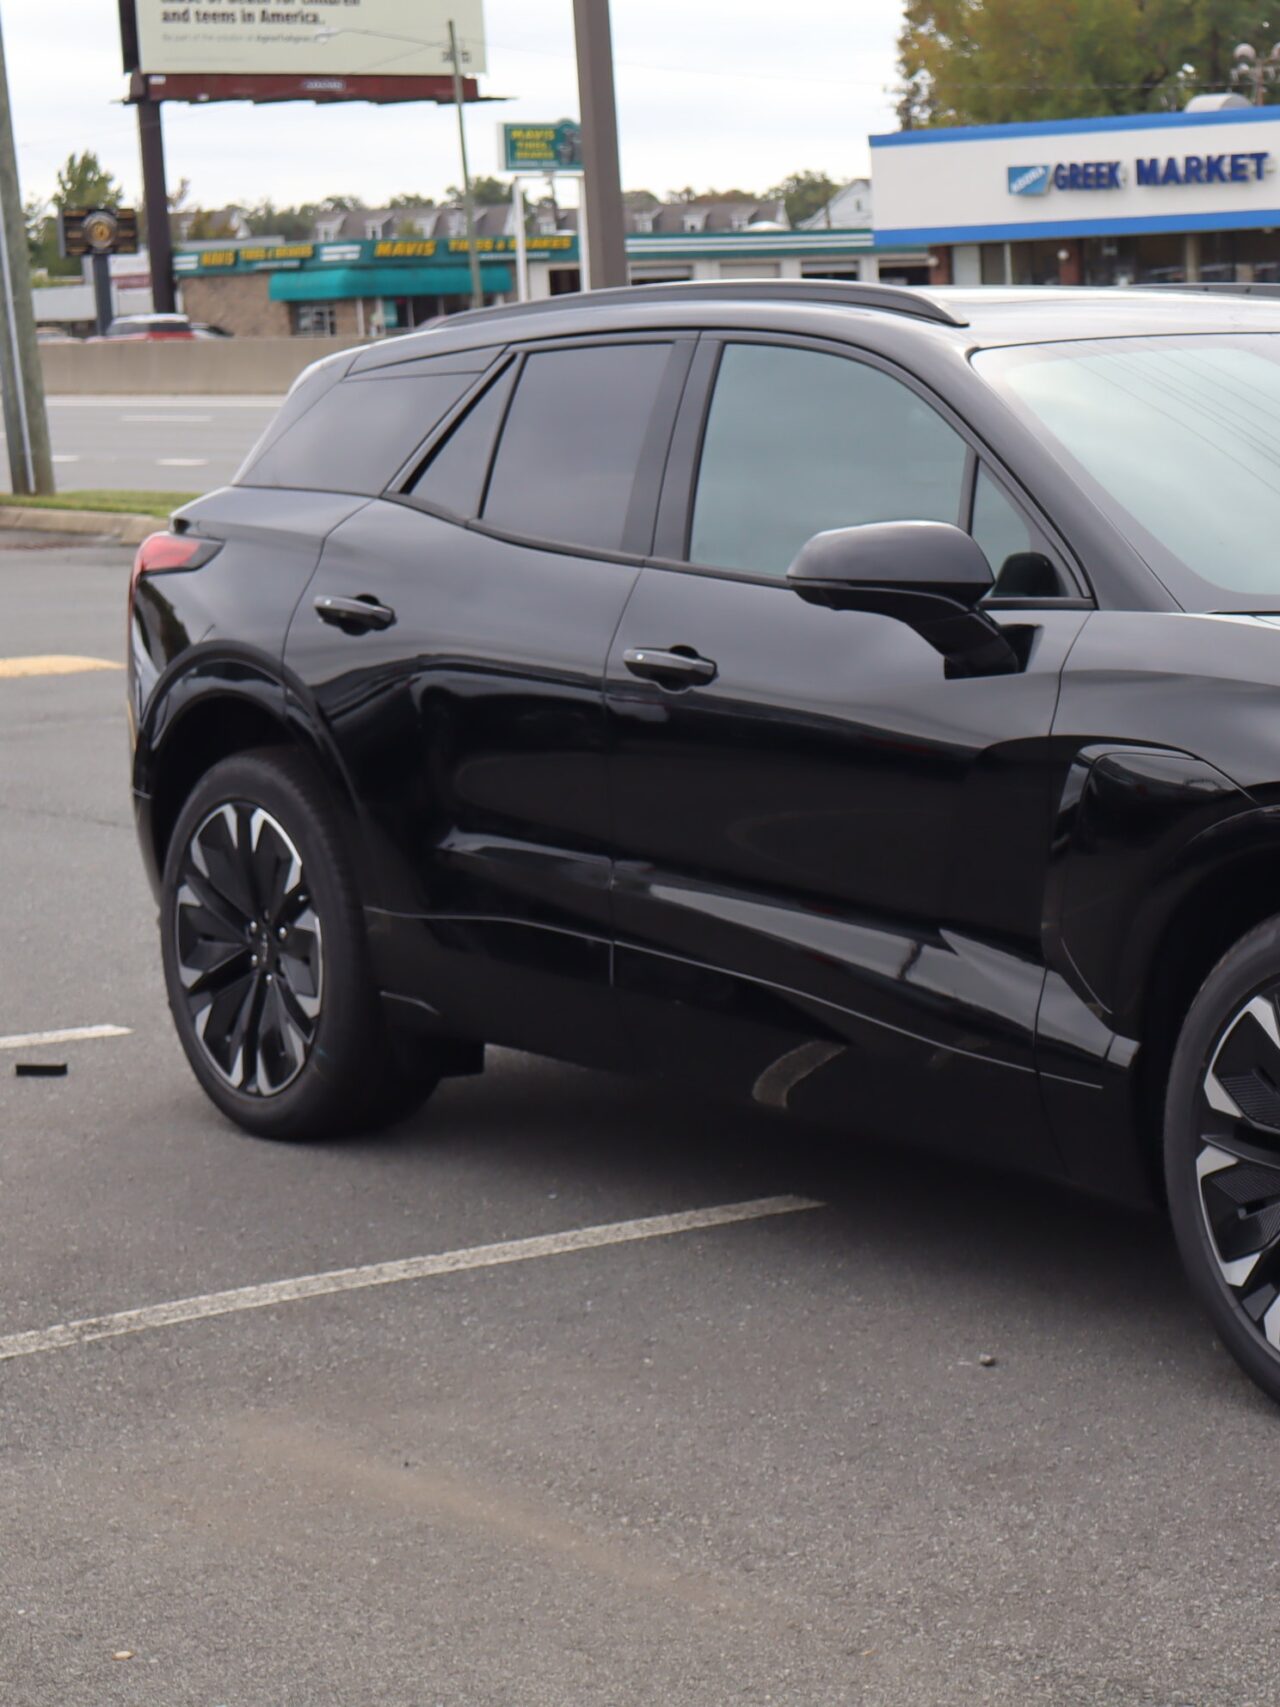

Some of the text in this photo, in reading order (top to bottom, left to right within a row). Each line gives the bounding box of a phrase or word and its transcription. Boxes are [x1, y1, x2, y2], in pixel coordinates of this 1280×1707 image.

[162, 9, 326, 25] and teens in America.
[511, 128, 555, 140] MAVIS
[1053, 161, 1123, 190] GREEK
[1135, 152, 1270, 187] MARKET
[374, 239, 437, 257] MAVIS
[508, 236, 572, 251] BAKES
